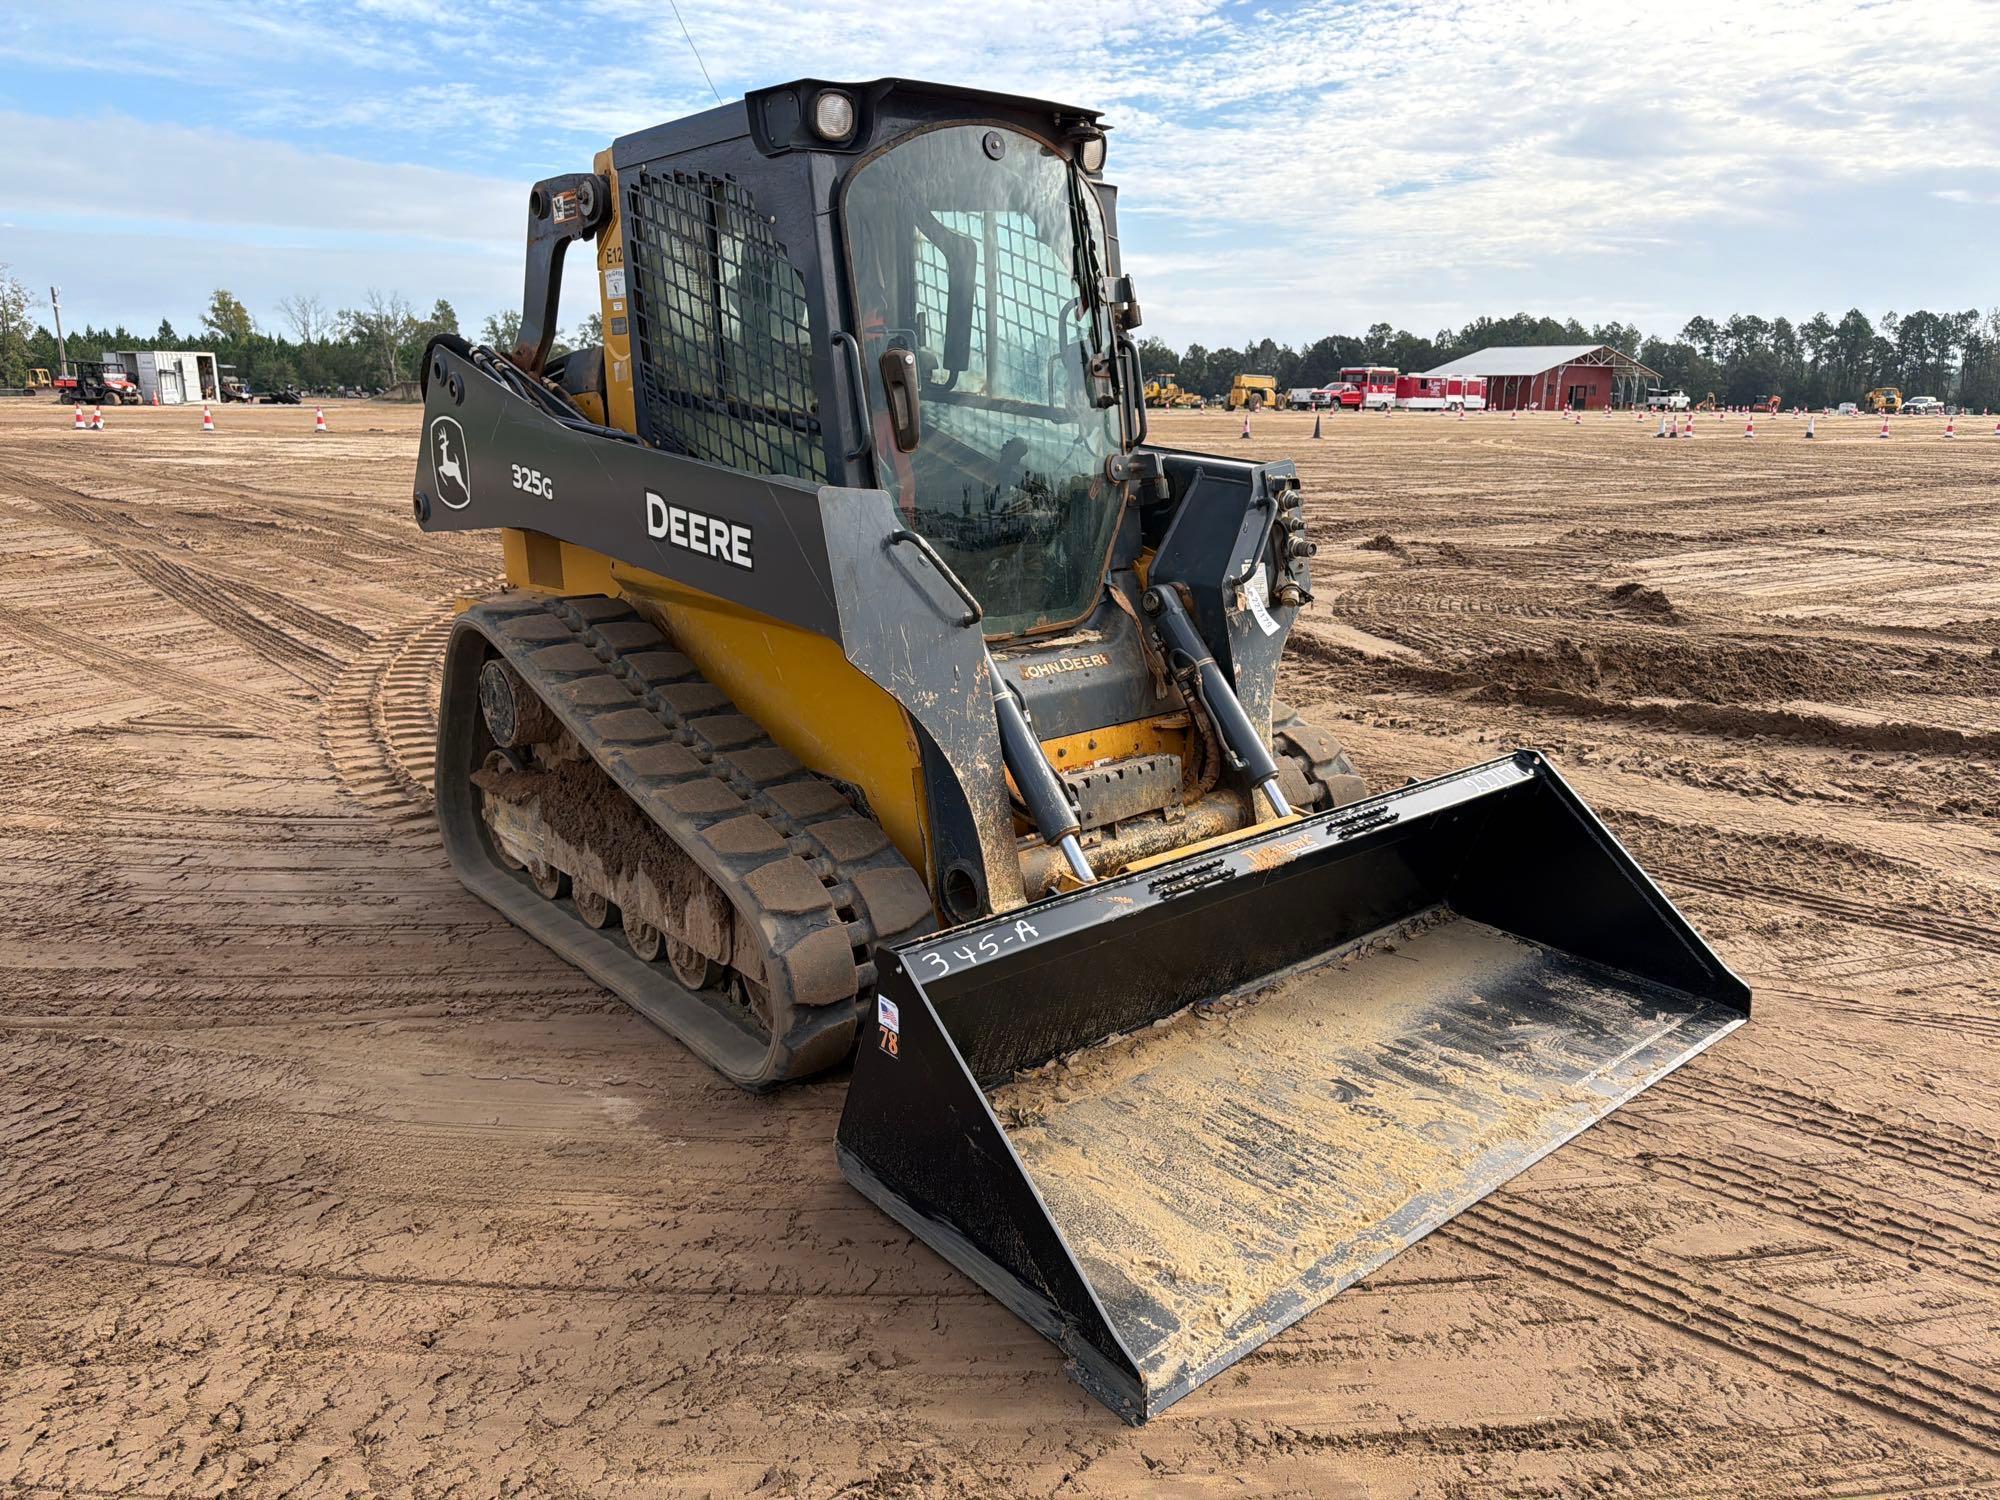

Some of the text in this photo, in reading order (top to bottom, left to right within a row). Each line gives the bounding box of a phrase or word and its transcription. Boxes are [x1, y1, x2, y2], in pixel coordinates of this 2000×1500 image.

[511, 463, 553, 500] 325G
[646, 491, 752, 569] DEERE
[921, 919, 1039, 977] 345-A
[879, 1025, 898, 1055] 78
